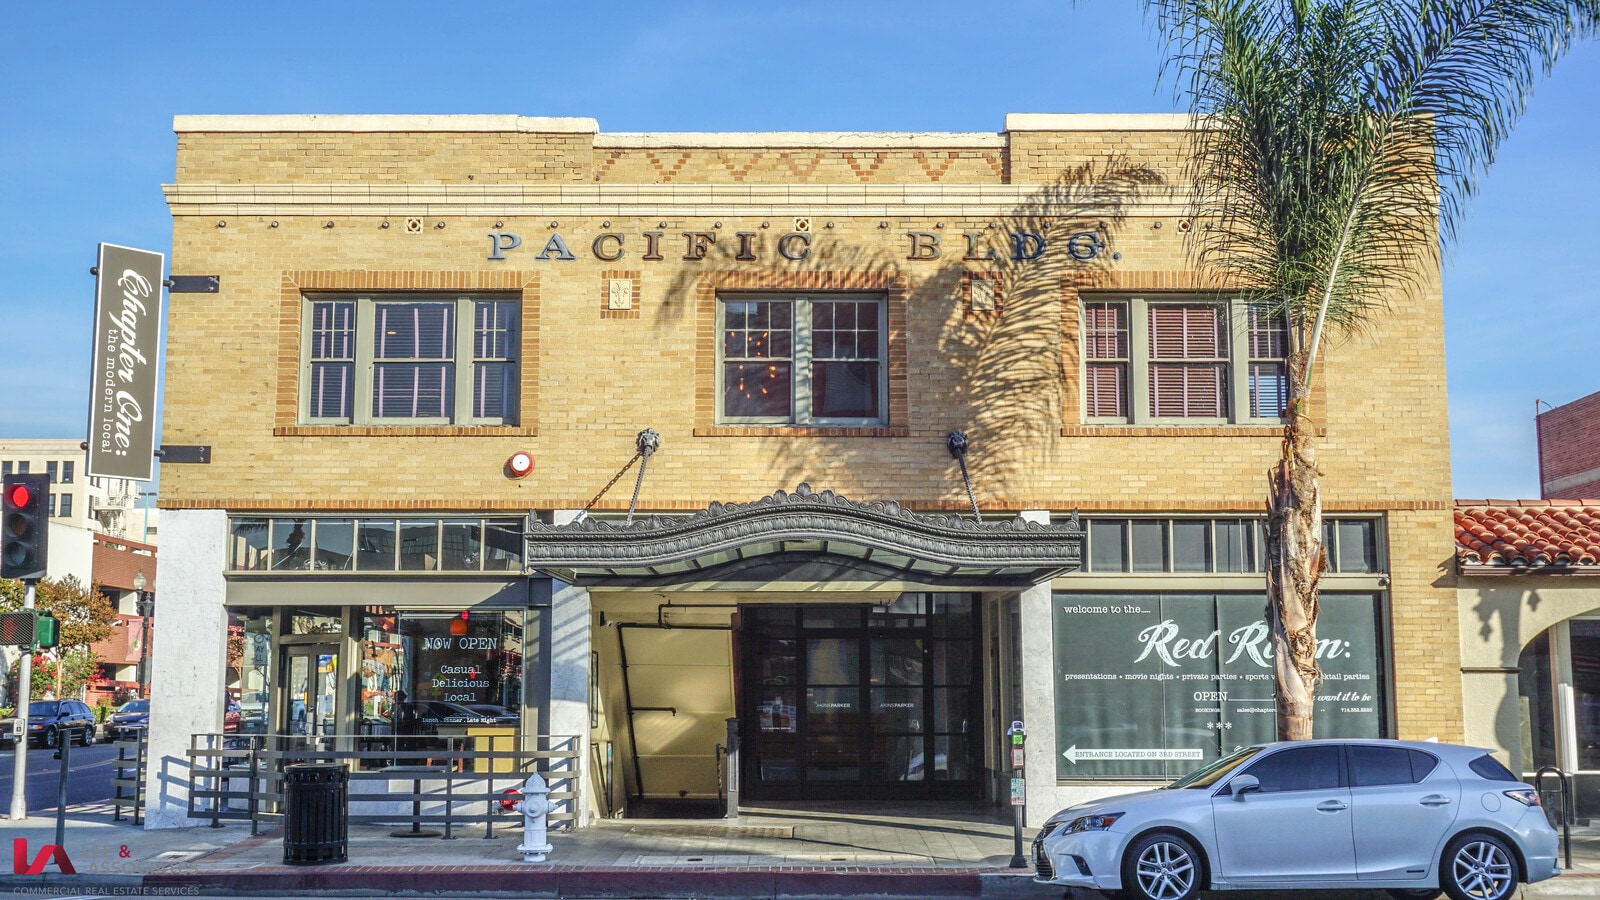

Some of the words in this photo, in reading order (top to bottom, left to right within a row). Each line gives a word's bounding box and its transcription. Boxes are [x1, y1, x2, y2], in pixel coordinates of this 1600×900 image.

[486, 231, 812, 262] PACIFIC
[905, 231, 1122, 262] BLDG.
[109, 269, 152, 382] Chapter
[107, 329, 118, 352] the
[103, 357, 116, 412] modern
[115, 390, 143, 456] One:
[101, 417, 113, 453] local
[1064, 604, 1108, 614] welcome
[1110, 605, 1121, 614] to
[423, 637, 452, 650] NOW
[459, 637, 498, 650] OPEN
[1133, 619, 1222, 667] Red
[440, 665, 481, 674] Casual
[432, 678, 490, 688] Delicious
[1065, 672, 1117, 681] presentations
[1125, 672, 1148, 680] movie
[1149, 673, 1174, 682] nights
[1182, 673, 1209, 682] private
[1210, 673, 1237, 682] parties
[1244, 673, 1269, 682] sports
[1343, 673, 1370, 682] parties
[444, 692, 477, 702] Local
[1193, 691, 1228, 701] OPEN
[1317, 692, 1342, 702] want
[1342, 691, 1351, 702] it
[1351, 691, 1361, 702] to
[1361, 693, 1372, 702] be
[480, 716, 497, 724] Night
